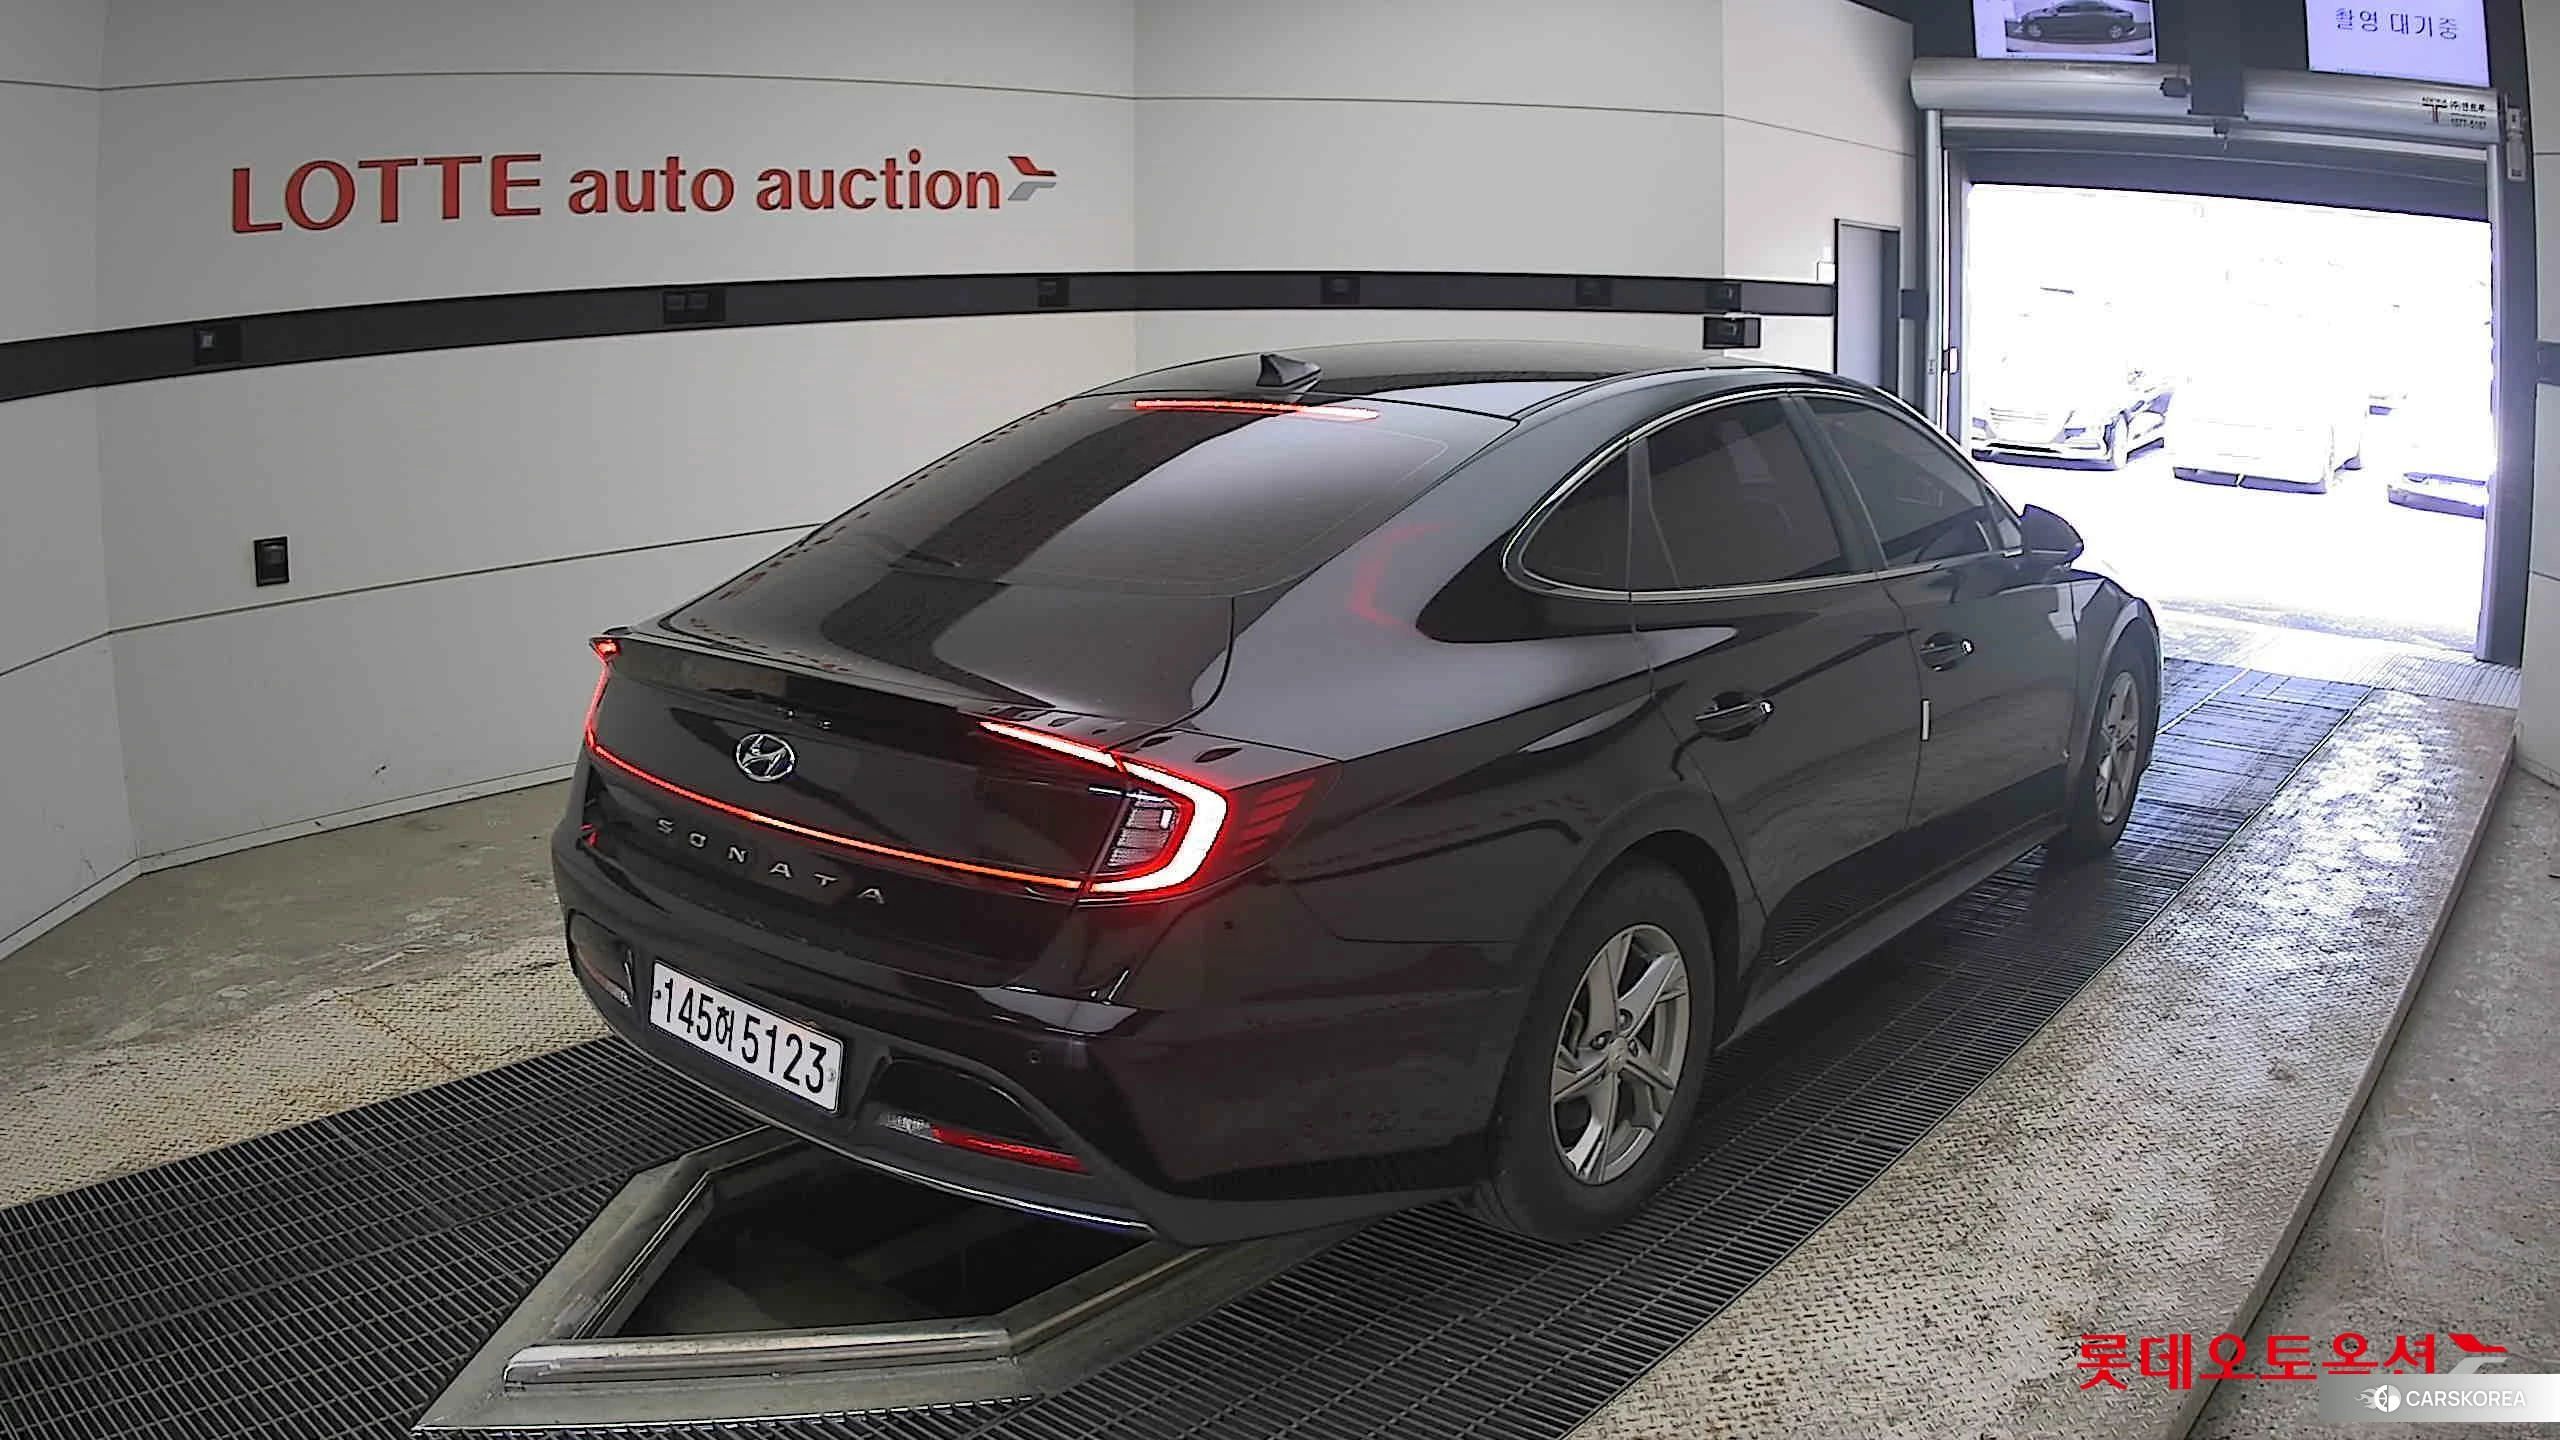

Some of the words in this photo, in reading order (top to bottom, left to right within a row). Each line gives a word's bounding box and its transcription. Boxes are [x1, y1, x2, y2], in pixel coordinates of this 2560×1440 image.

[2335, 8, 2379, 33] 촬영
[231, 153, 544, 233] LOTTE
[567, 155, 735, 213] auto
[755, 148, 1001, 210] auction
[656, 818, 886, 905] SONATA
[664, 977, 735, 1052] 145허
[740, 1013, 827, 1094] 5123
